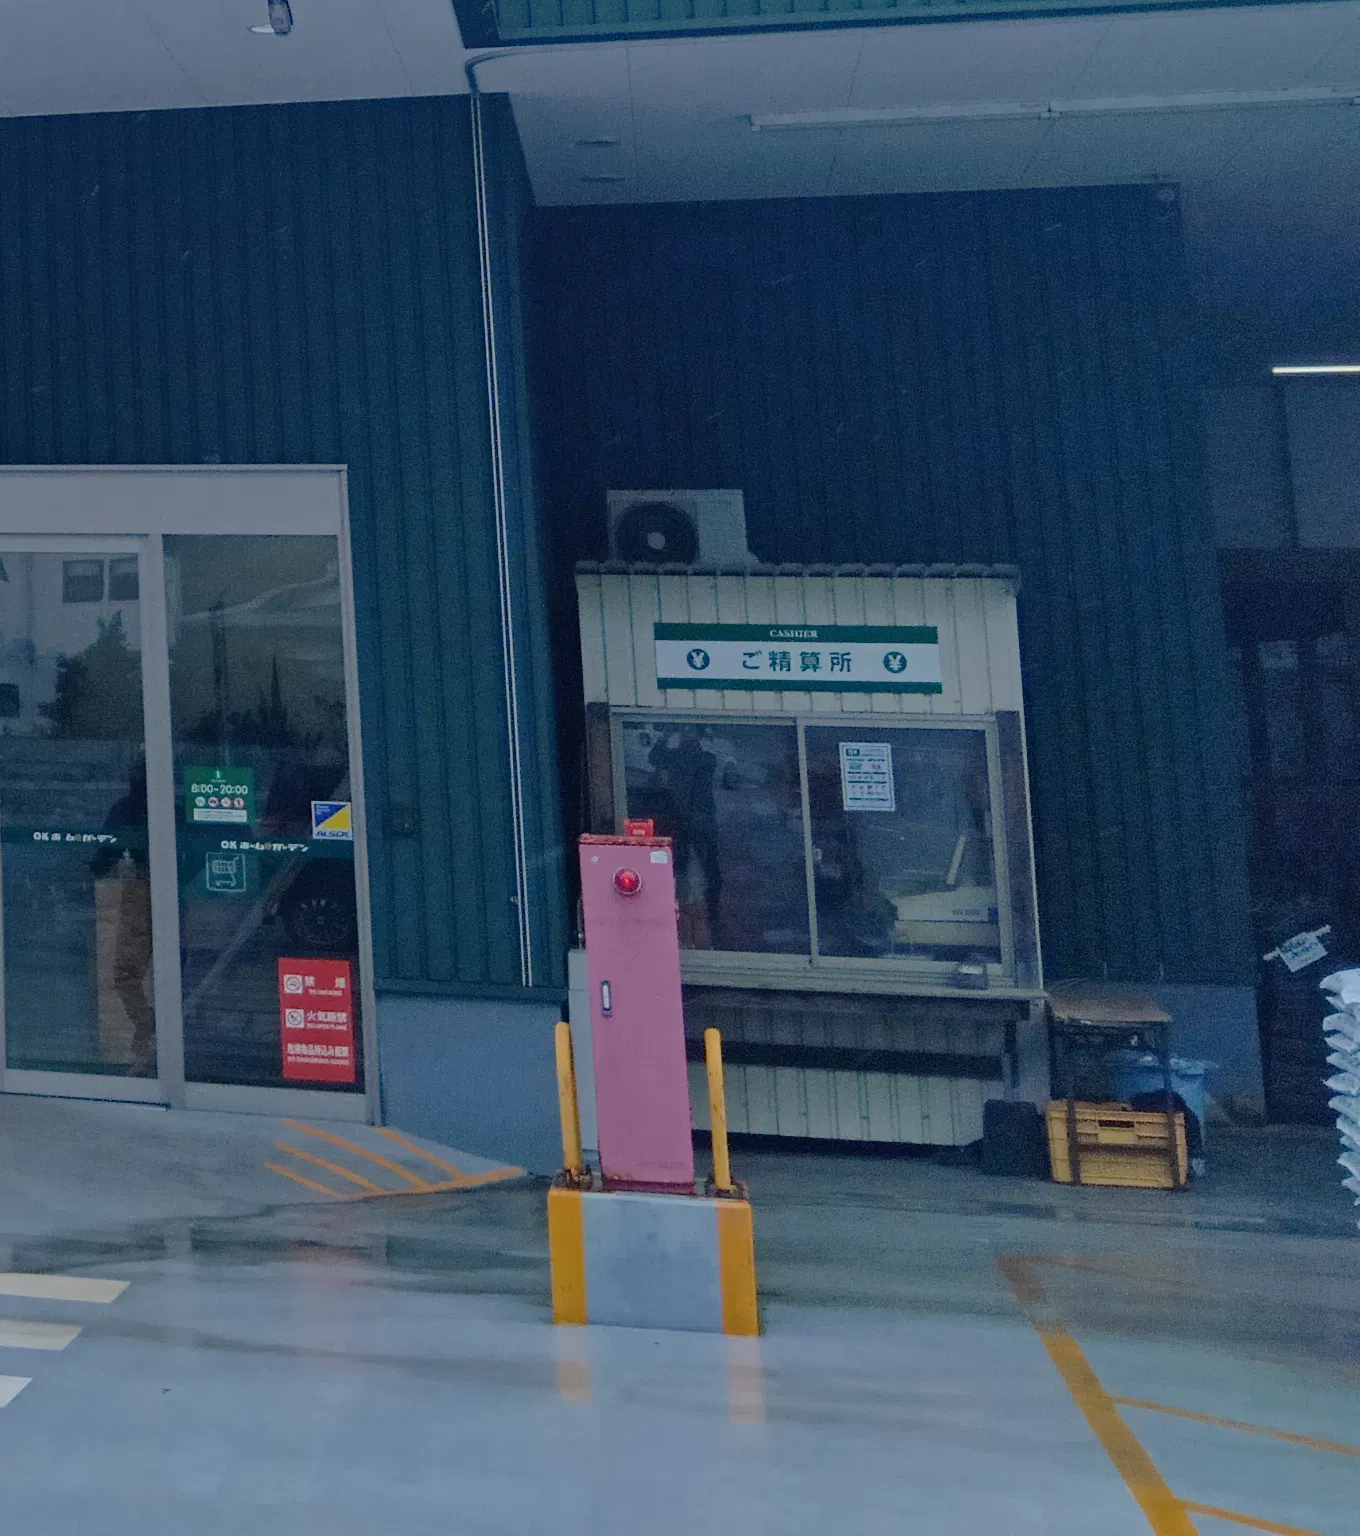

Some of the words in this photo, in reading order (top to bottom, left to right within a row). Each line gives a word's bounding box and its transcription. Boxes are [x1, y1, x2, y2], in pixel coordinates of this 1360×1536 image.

[769, 628, 819, 639] CASHIER
[742, 650, 853, 673] ご精算所
[33, 831, 49, 841] OK
[221, 840, 237, 850] OK
